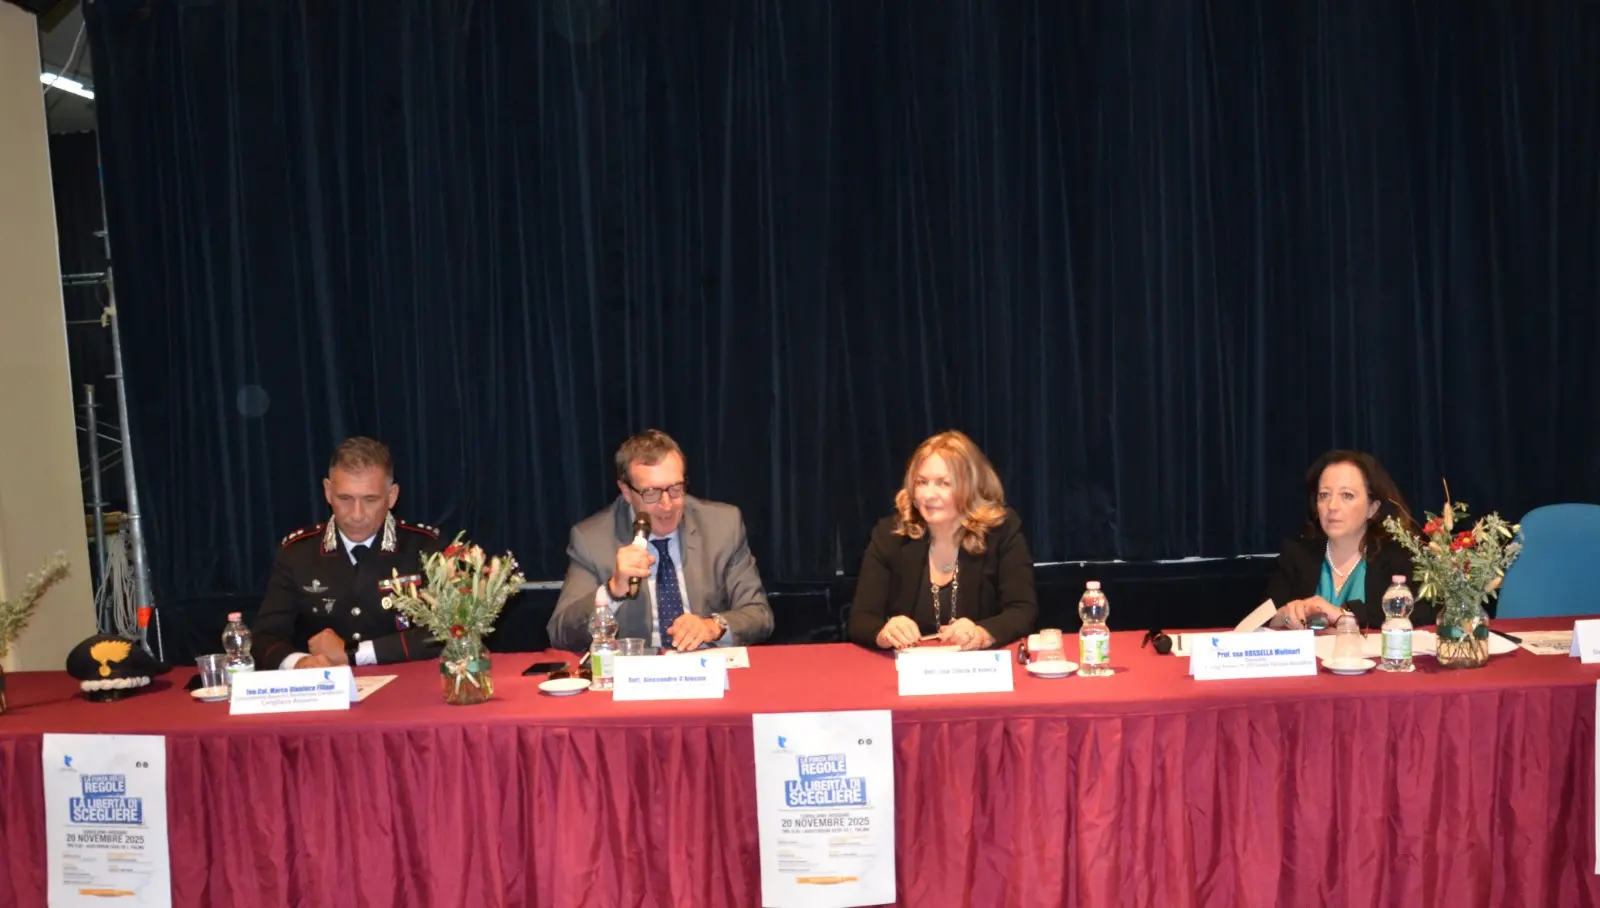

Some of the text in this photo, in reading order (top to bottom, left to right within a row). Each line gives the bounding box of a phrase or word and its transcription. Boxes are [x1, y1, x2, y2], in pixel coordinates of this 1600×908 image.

[1244, 649, 1273, 657] ROSSELLA
[801, 761, 846, 775] REGOLE
[85, 781, 125, 793] REGOLE
[789, 781, 802, 792] LA
[849, 778, 861, 790] DI
[789, 789, 862, 805] SCEGLIERE
[73, 798, 86, 809] LA
[127, 799, 138, 809] DI
[73, 808, 139, 821] SCEGLIERE
[781, 816, 870, 828] 20 NOVEMBRE 2025
[66, 833, 145, 844] 20 NOVEMBRE 2025
